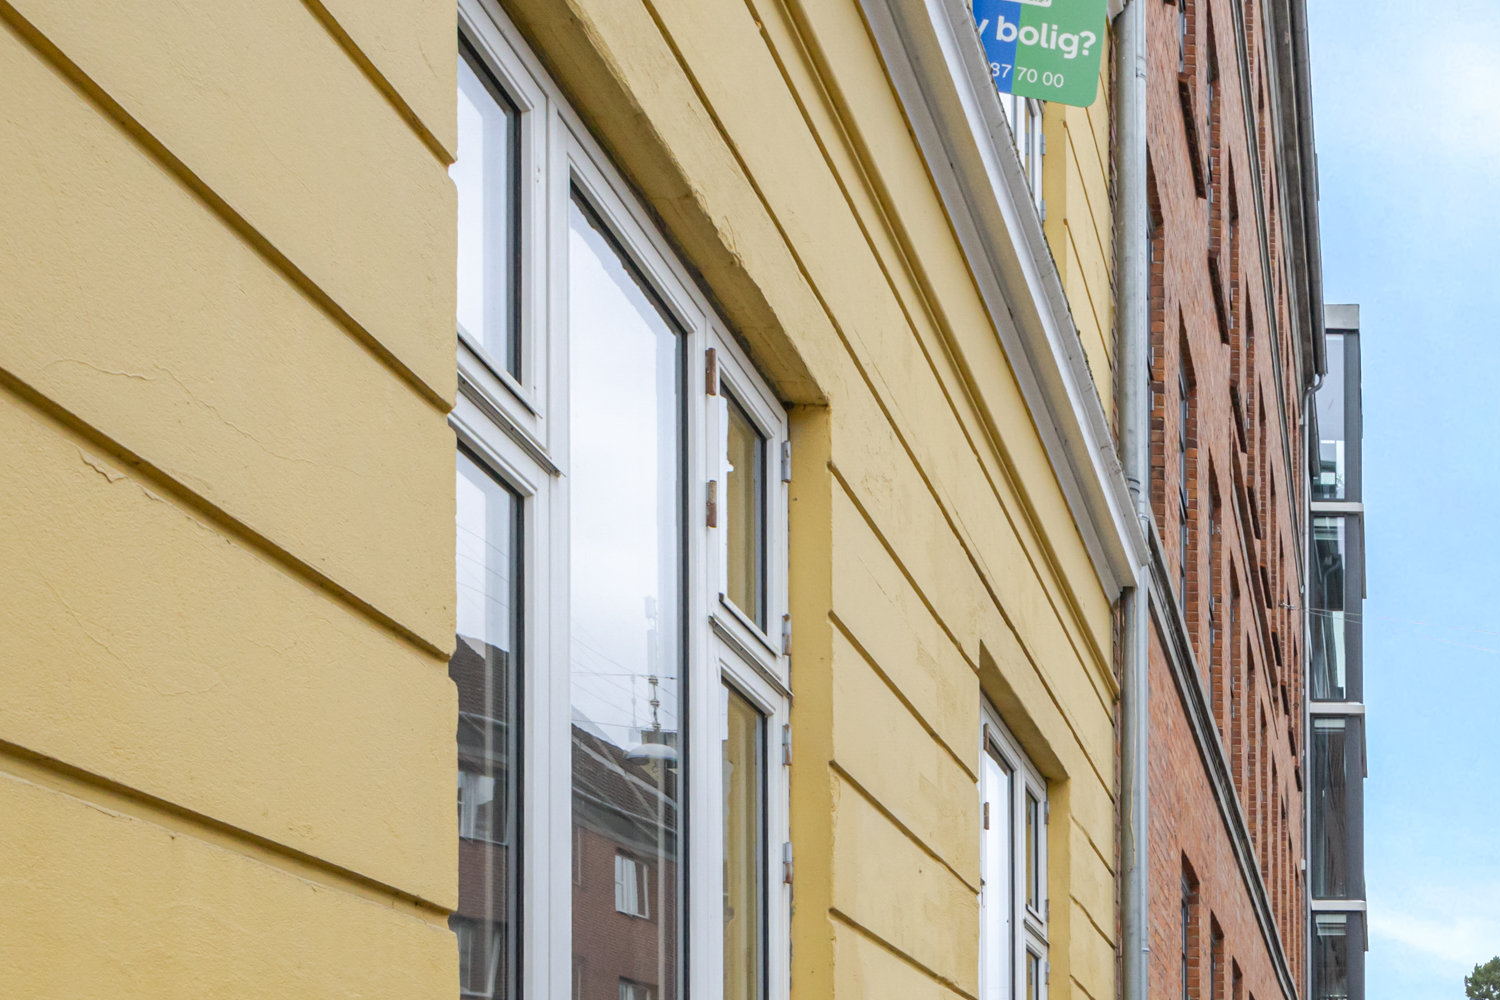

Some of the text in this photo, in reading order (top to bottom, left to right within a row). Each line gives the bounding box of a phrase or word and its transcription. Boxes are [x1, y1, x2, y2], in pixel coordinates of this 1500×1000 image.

[996, 15, 1097, 60] bolig?
[991, 62, 1064, 88] 87 70 00
